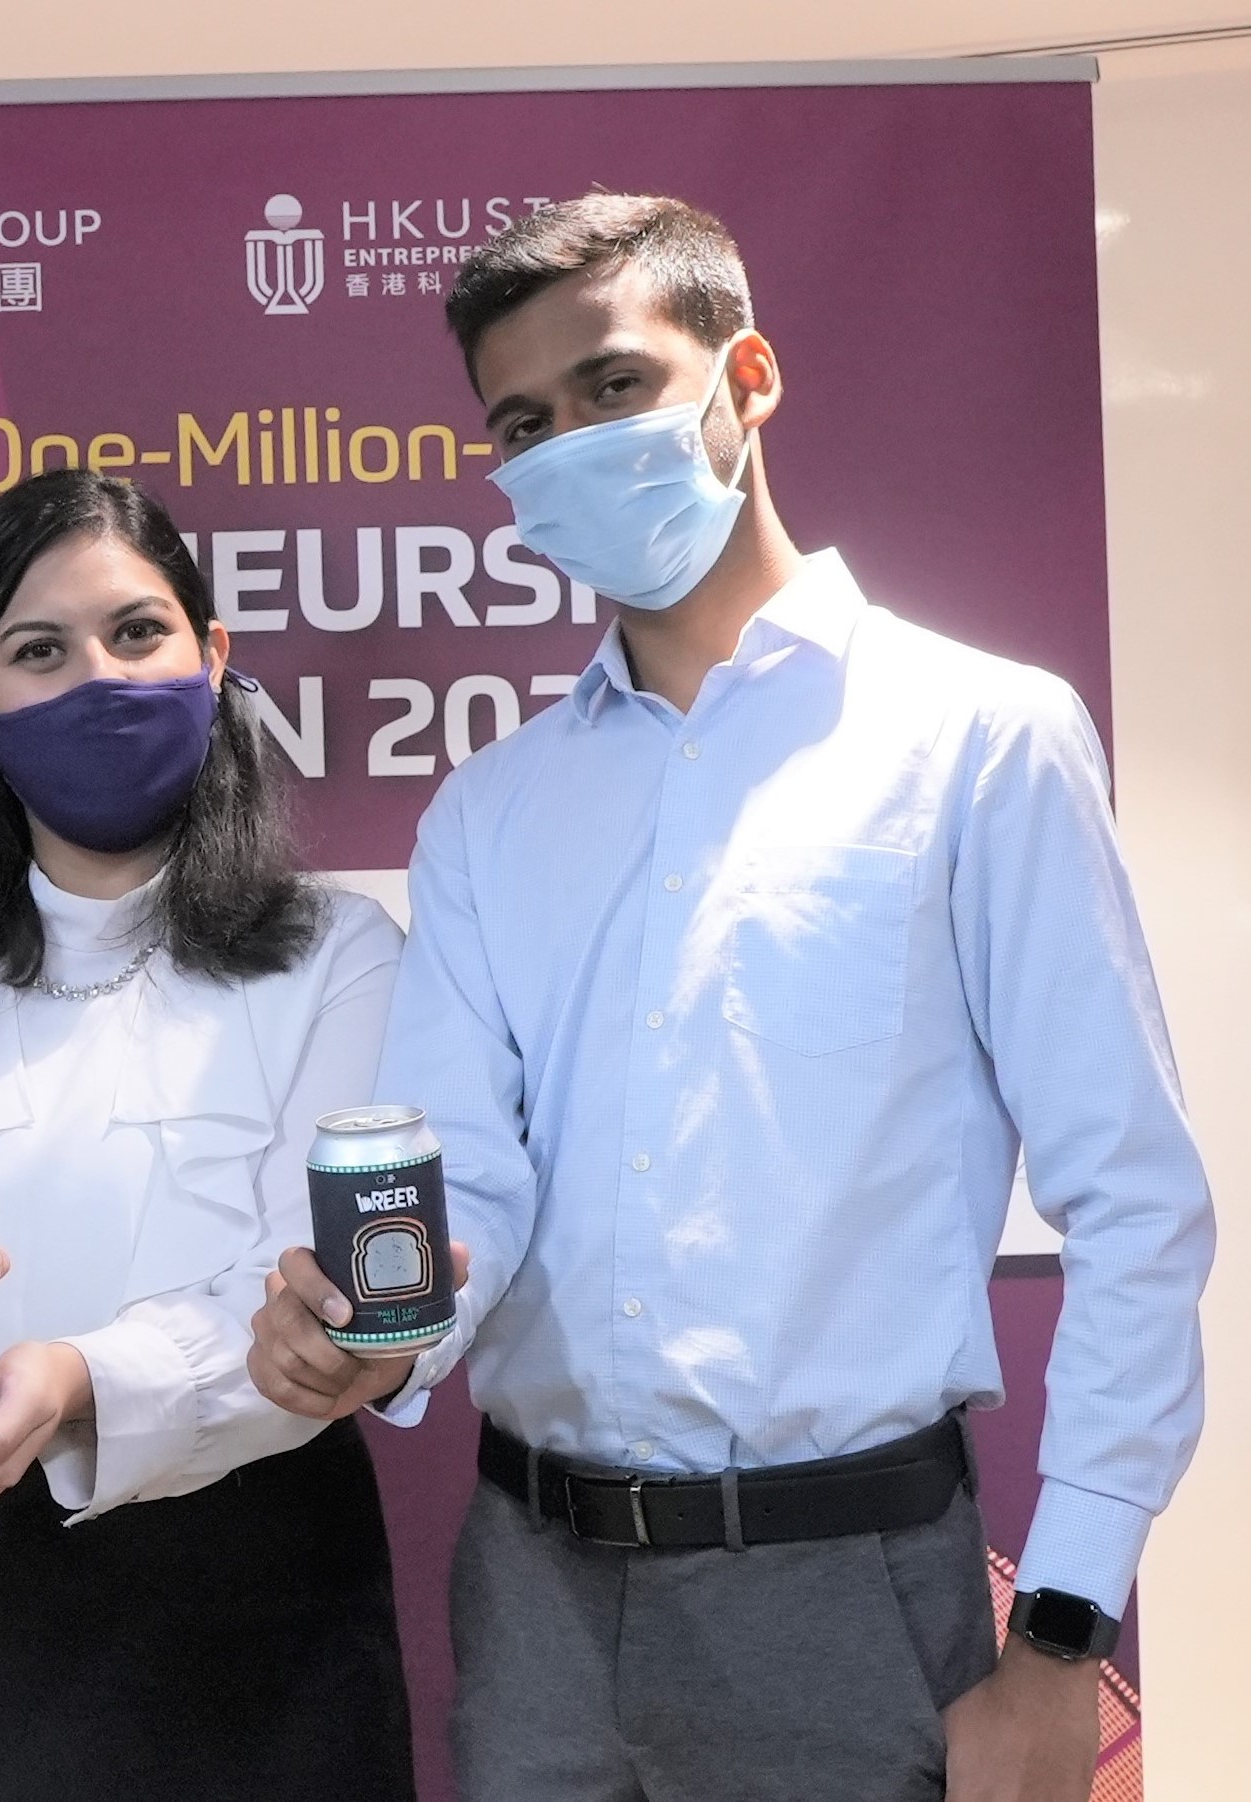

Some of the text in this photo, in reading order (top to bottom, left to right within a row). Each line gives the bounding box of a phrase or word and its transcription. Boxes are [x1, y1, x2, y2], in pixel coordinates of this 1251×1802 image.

[344, 245, 484, 267] ENTREPRE
[345, 271, 446, 298] 香港科
[367, 674, 582, 777] 20
